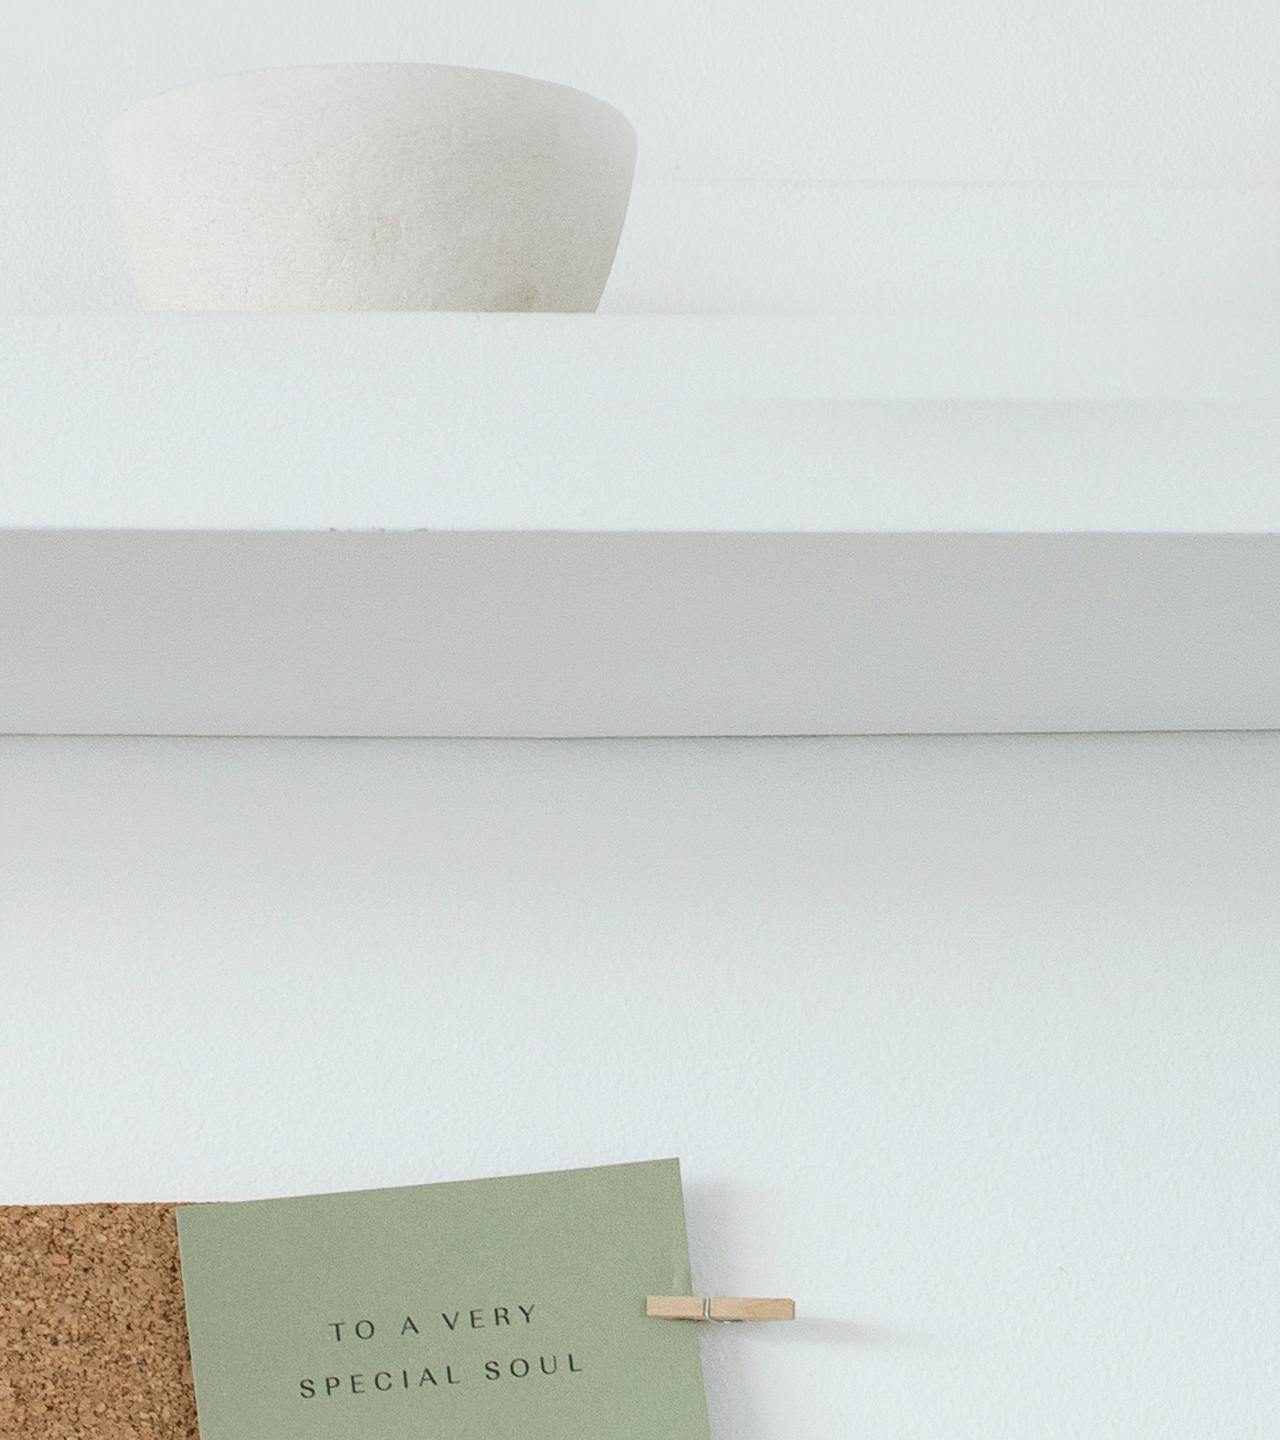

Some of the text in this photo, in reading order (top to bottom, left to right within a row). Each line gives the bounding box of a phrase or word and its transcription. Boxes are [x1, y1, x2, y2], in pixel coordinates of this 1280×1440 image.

[328, 1304, 537, 1342] TO A VERY
[299, 1352, 583, 1399] SPECIAL SOUL
